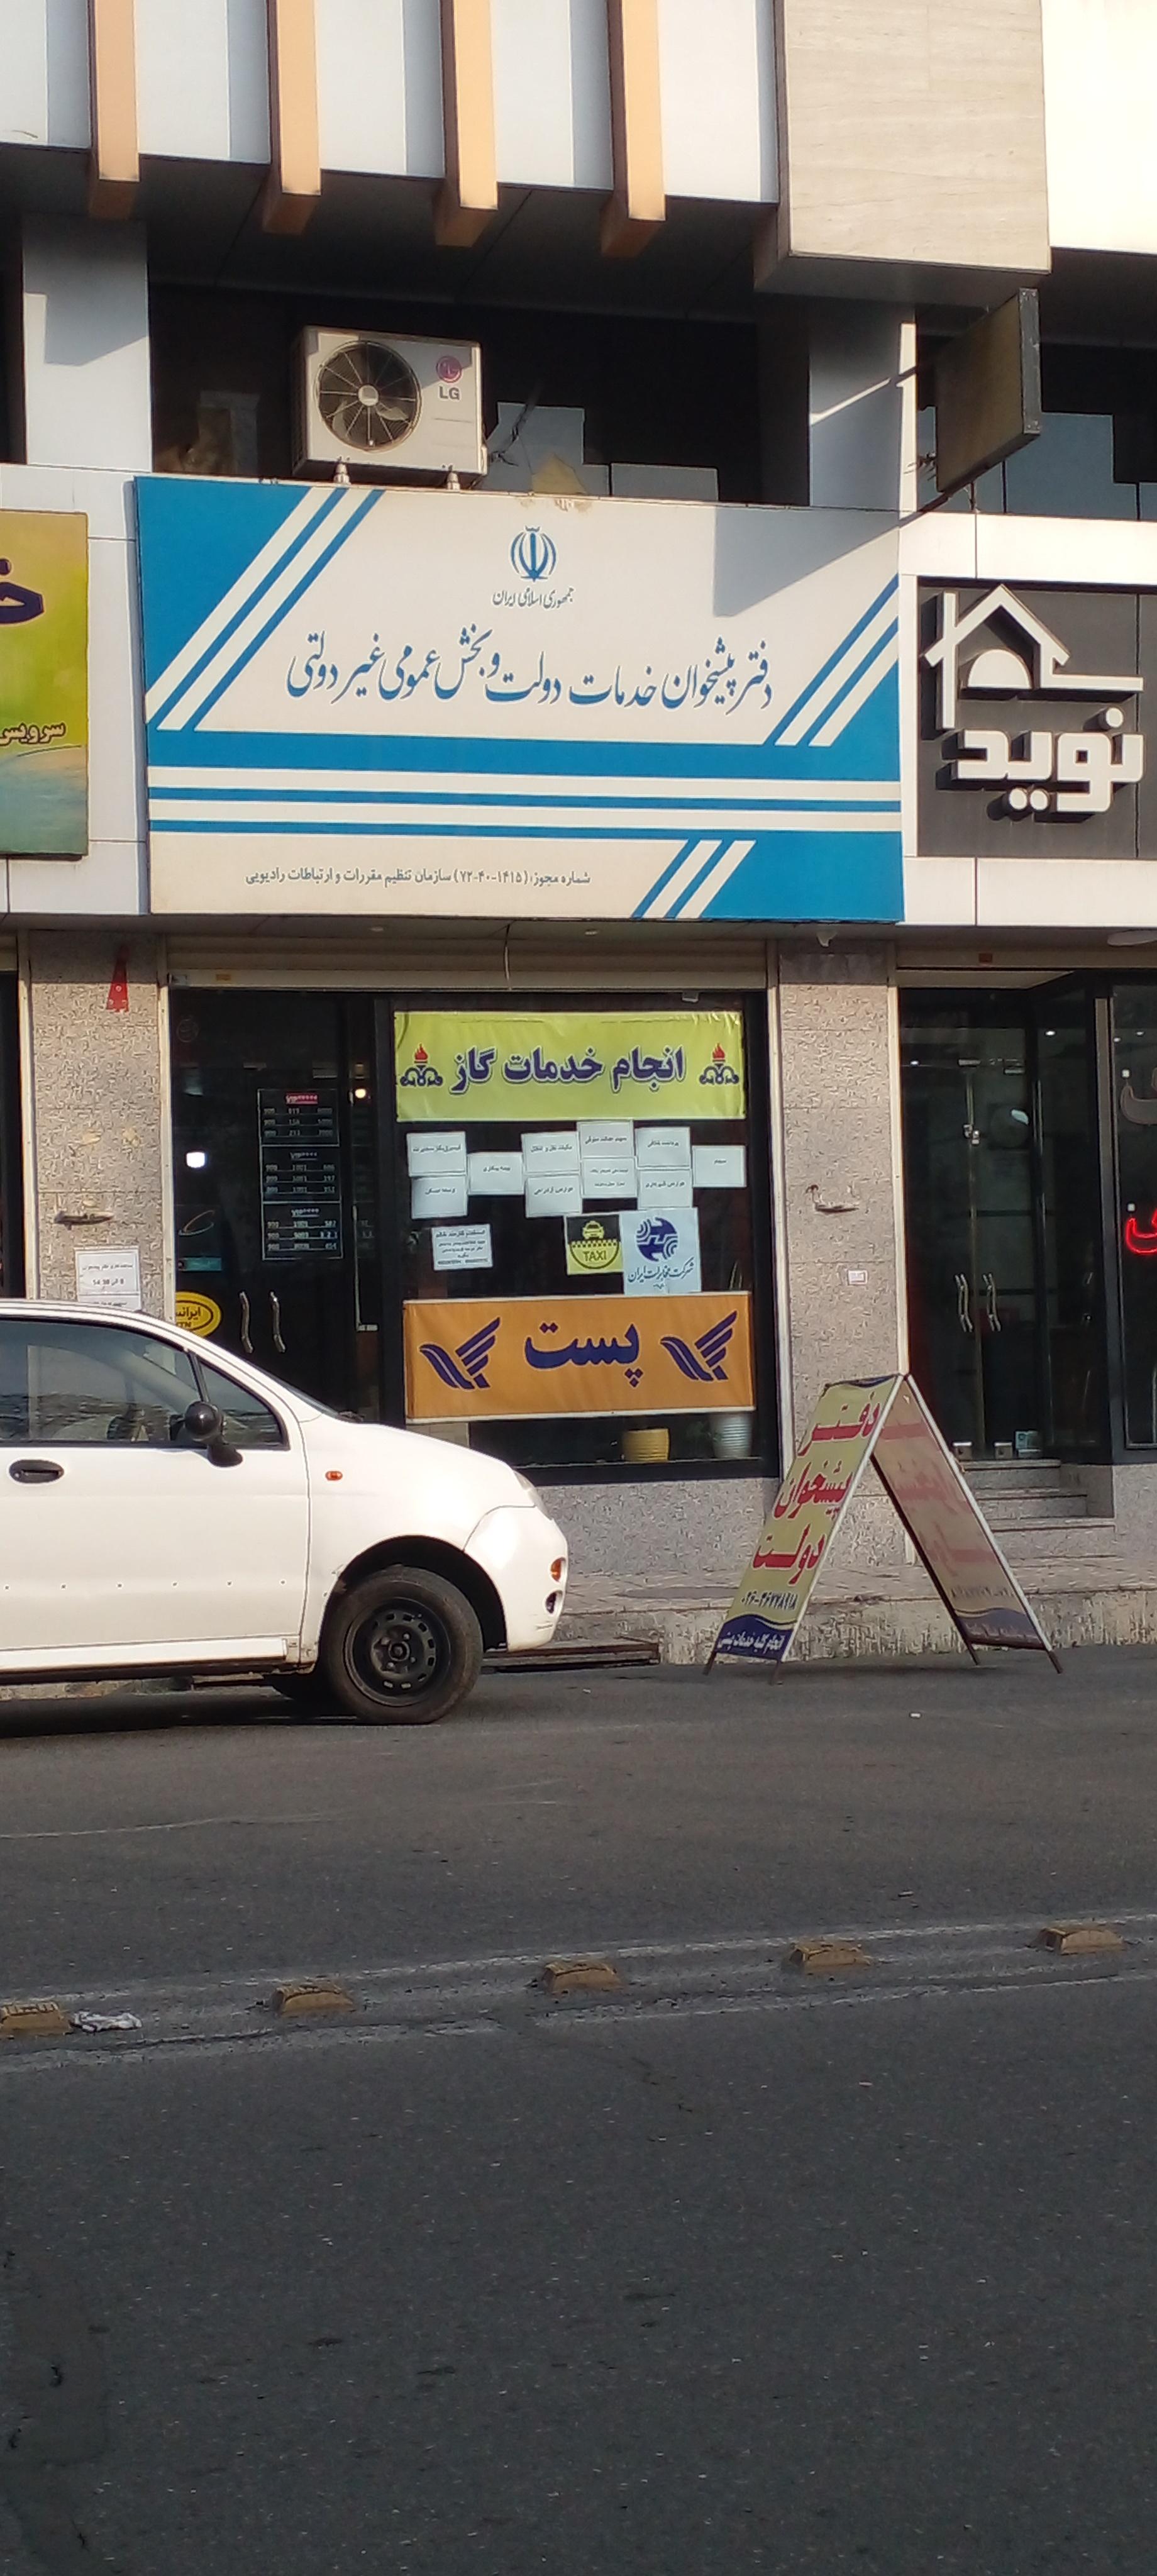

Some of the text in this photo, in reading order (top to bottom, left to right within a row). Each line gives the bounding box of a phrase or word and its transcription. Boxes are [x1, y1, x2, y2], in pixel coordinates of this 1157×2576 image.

[439, 386, 460, 400] LG
[492, 587, 574, 609] جمهوری اسلامی ایران
[286, 630, 338, 699] دولتی
[331, 633, 385, 705] غیر
[379, 645, 440, 701] عمومی
[435, 624, 493, 699] بخش
[485, 652, 562, 704] دولت
[661, 636, 737, 709] پیشخوان
[726, 640, 772, 716] دفتر
[569, 665, 657, 708] خدمات
[956, 706, 1144, 812] نوید
[245, 867, 285, 885] رادیویی
[287, 867, 333, 884] ارتباطات
[335, 872, 341, 885] و
[343, 868, 382, 886] مقررات
[384, 868, 412, 888] تنظیم
[414, 868, 451, 885] سازمان
[561, 870, 591, 887] شماره
[449, 1046, 686, 1094] انجام خدمات گاز
[582, 1250, 607, 1262] TAXI
[628, 1265, 647, 1283] ایران
[668, 1257, 695, 1280] شرکت
[524, 1322, 643, 1387] پست
[797, 1392, 881, 1457] دفتر
[773, 1460, 853, 1519] پیشخوان
[752, 1523, 824, 1585] دولت
